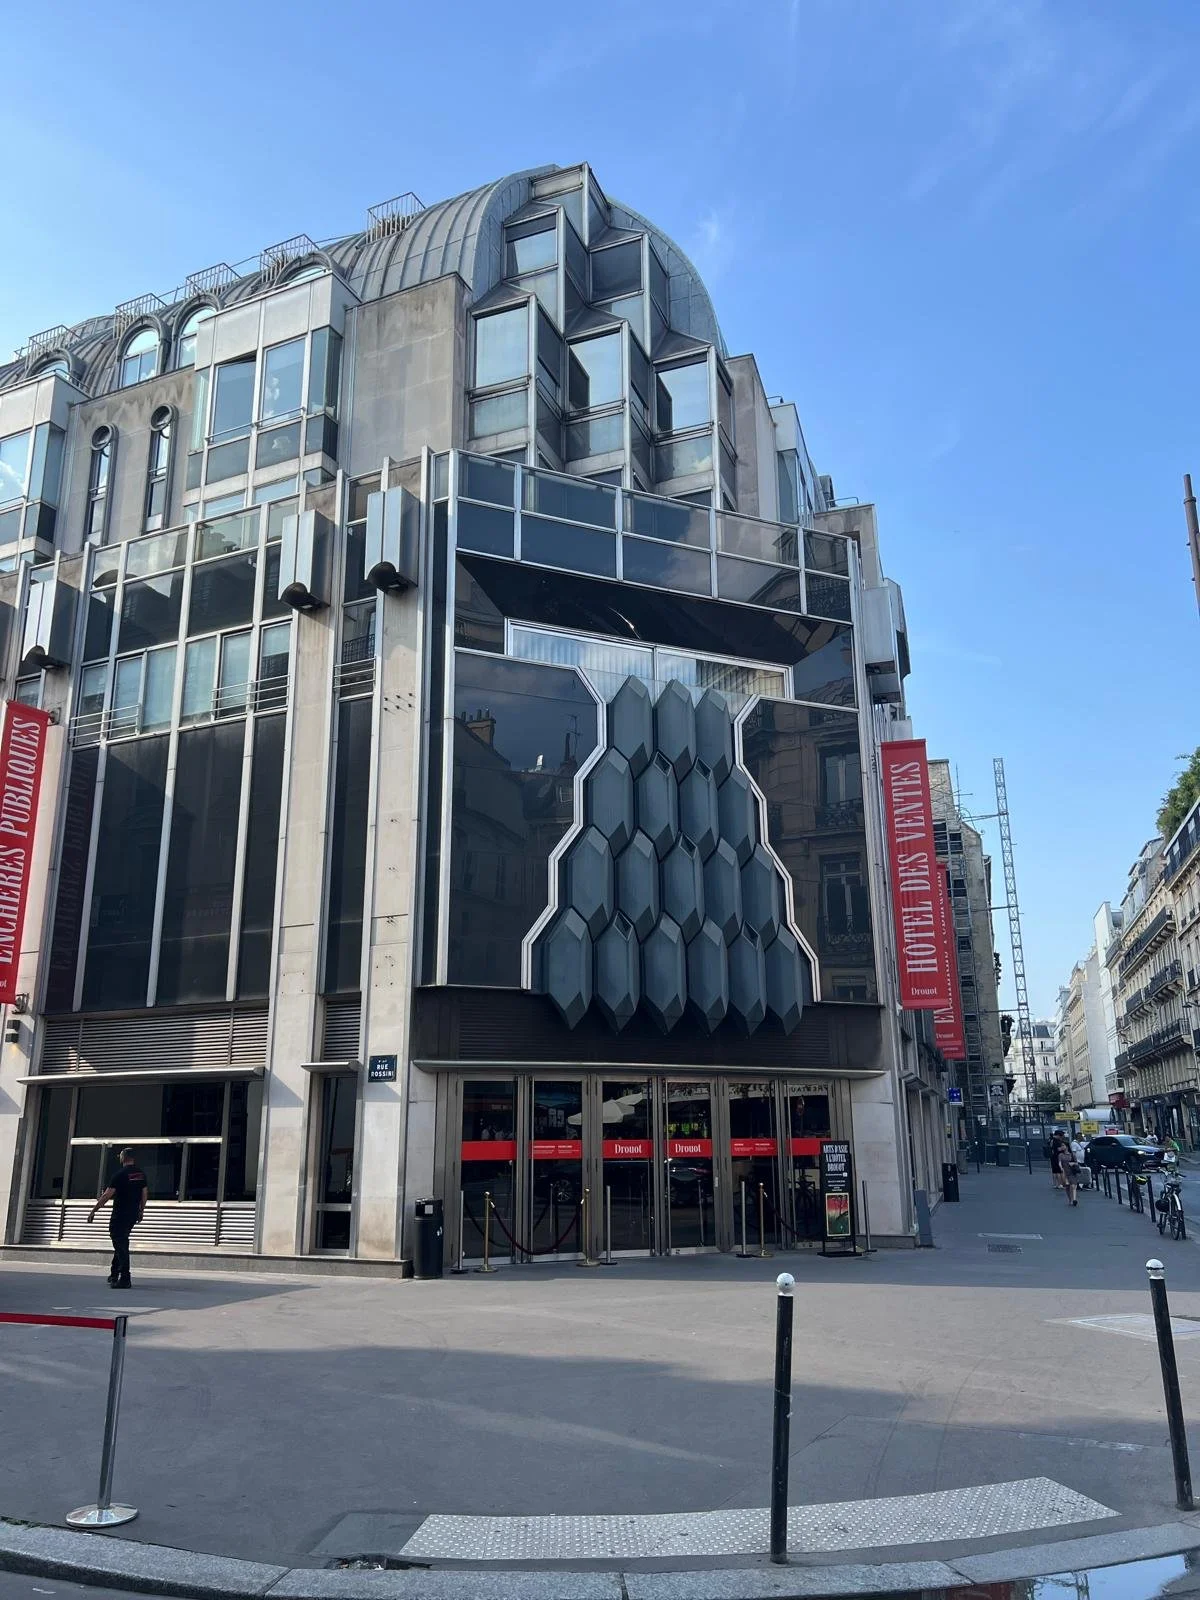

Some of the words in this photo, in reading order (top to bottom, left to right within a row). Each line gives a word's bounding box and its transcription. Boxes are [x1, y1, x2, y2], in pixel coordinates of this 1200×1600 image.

[0, 716, 40, 838] PUBLIQUES
[890, 762, 926, 843] VENTES
[898, 852, 931, 892] DES
[902, 901, 938, 973] HÔTEL
[911, 987, 938, 996] Drouot
[614, 1144, 642, 1153] Drouot
[675, 1144, 701, 1153] Drouot
